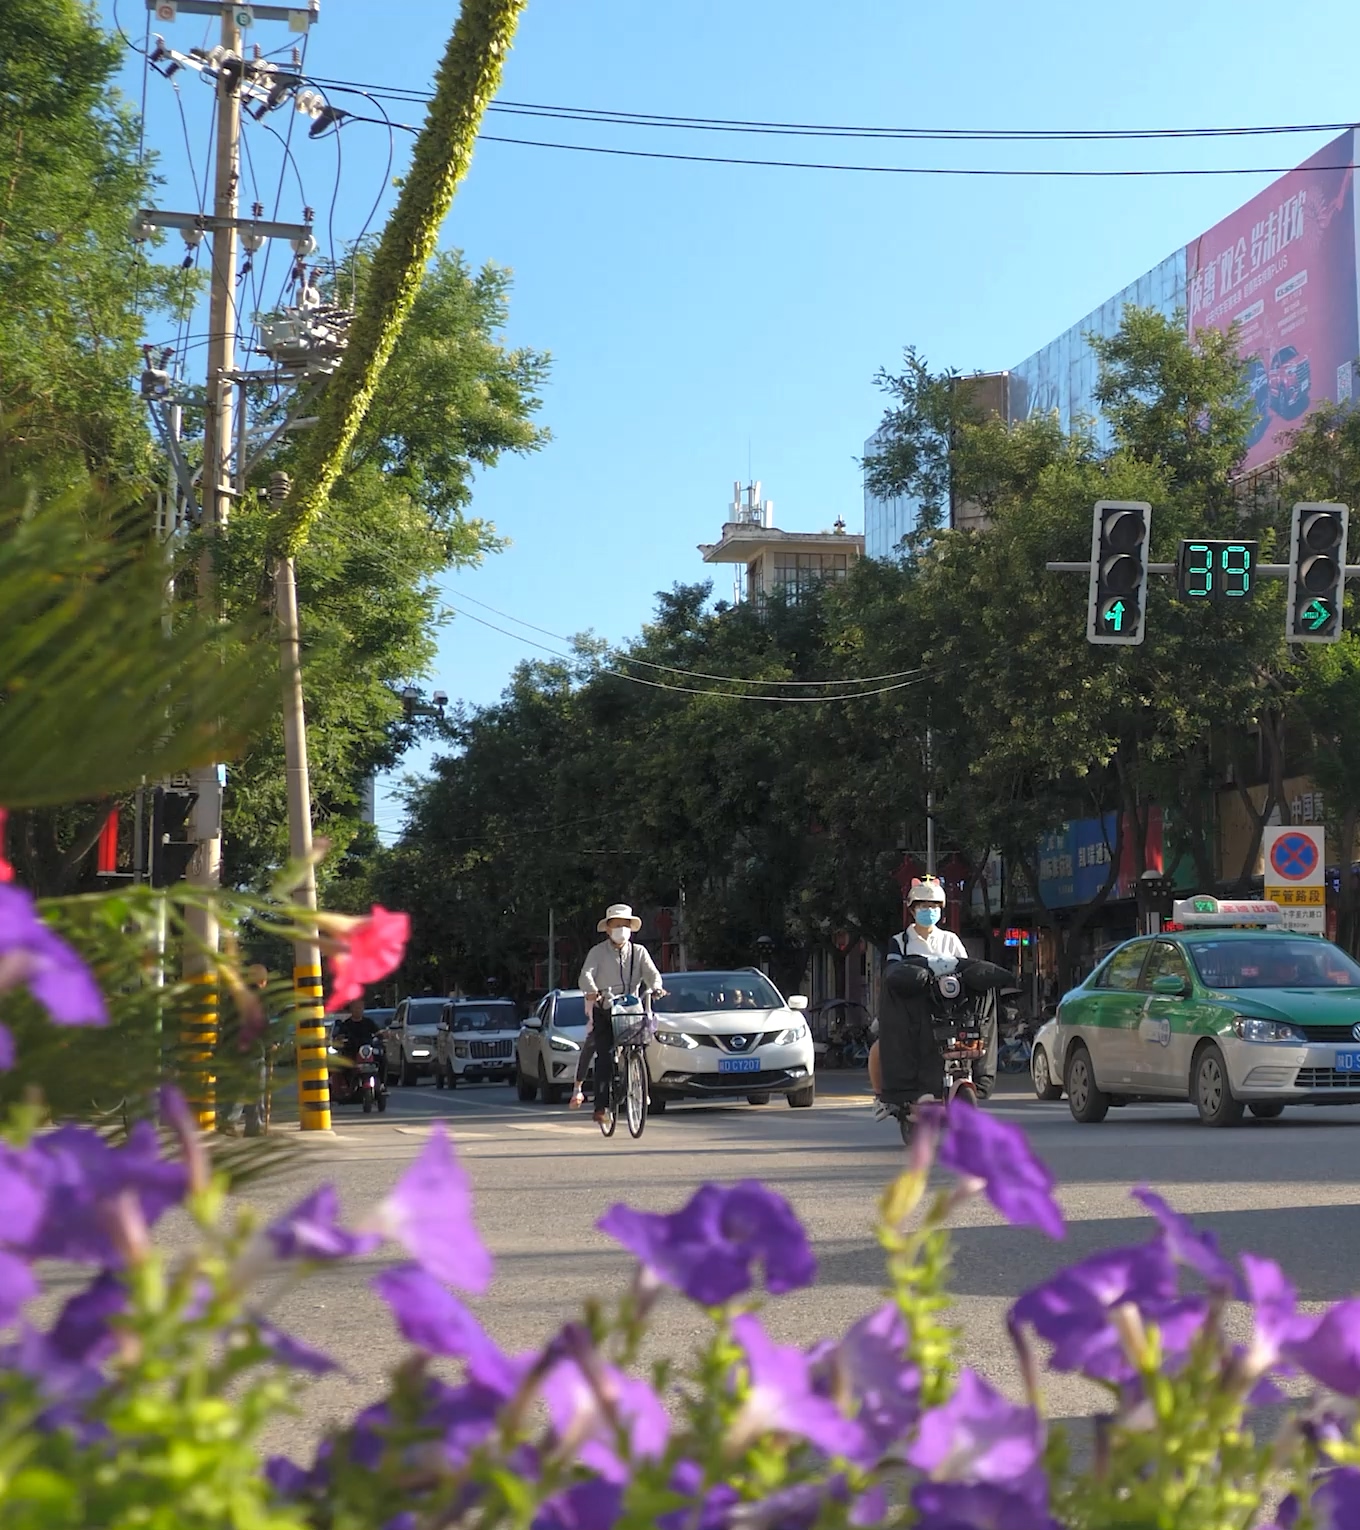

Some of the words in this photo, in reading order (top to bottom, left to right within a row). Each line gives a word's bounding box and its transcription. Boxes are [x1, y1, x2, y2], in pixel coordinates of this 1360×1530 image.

[1188, 545, 1251, 596] 39
[1269, 889, 1321, 903] 严管路段
